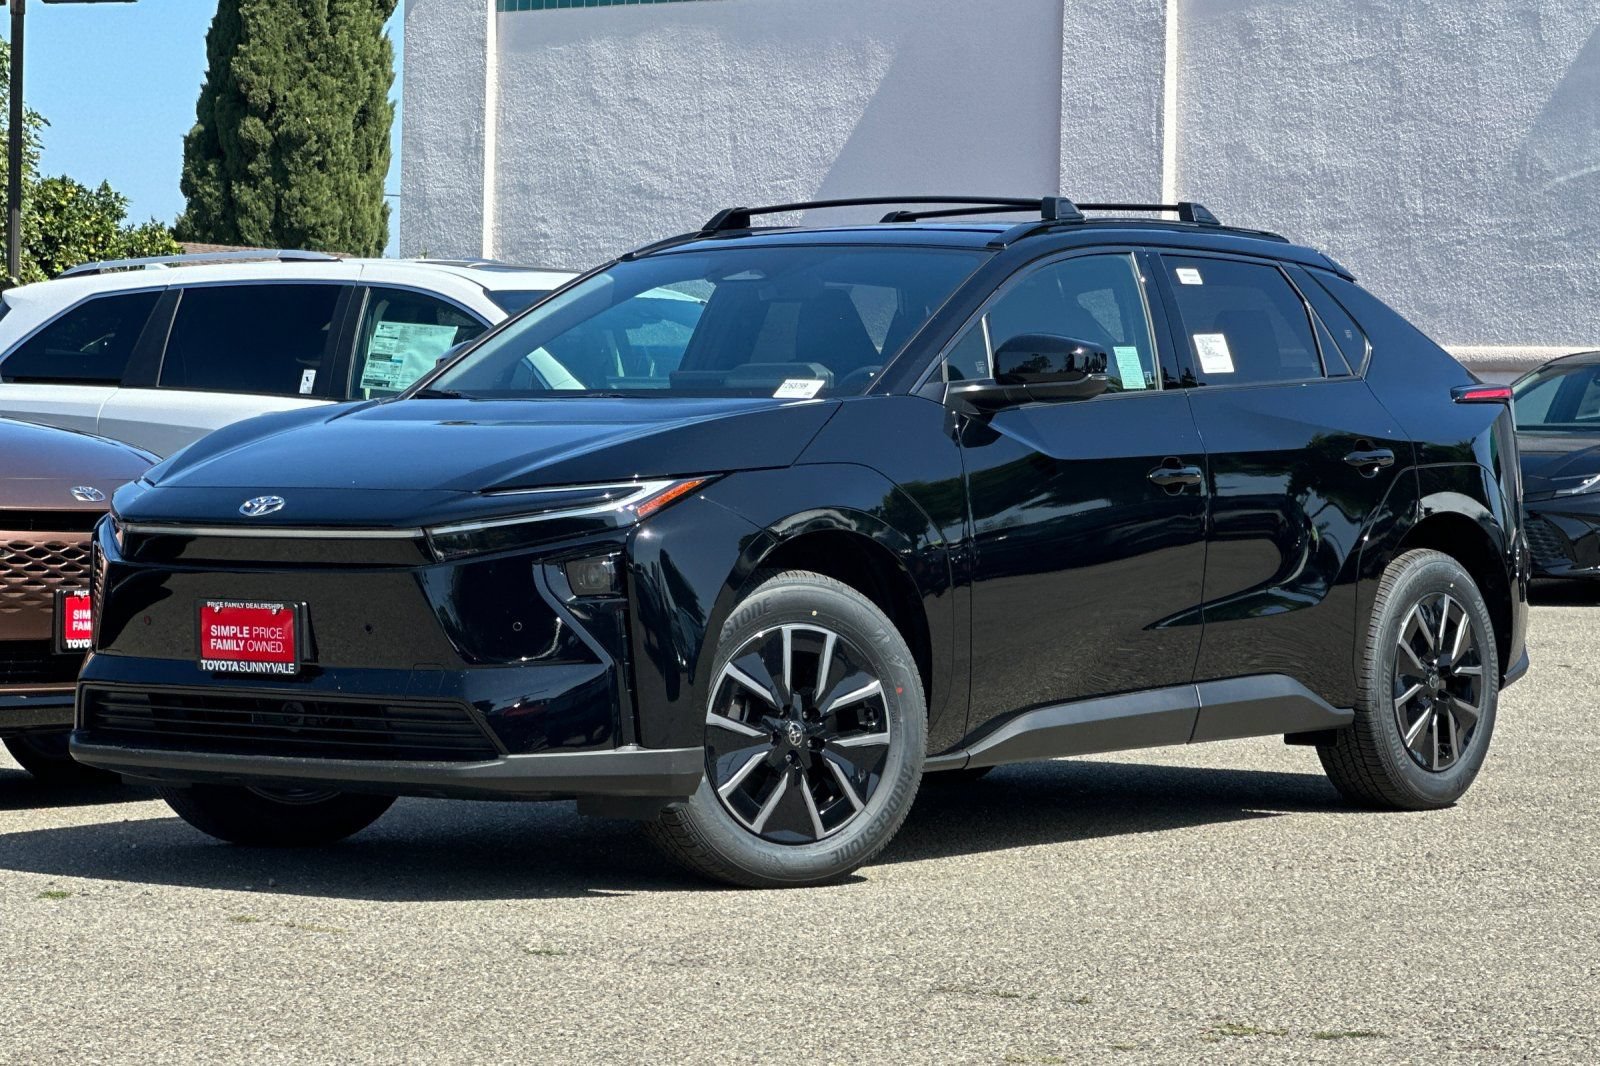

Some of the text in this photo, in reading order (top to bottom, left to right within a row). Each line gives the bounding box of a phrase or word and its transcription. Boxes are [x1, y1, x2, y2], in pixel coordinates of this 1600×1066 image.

[245, 602, 285, 610] DEALERSHIPS
[210, 625, 286, 639] SIMPLE PRICE.
[66, 638, 92, 649] TOYO
[210, 638, 286, 653] FAMILY OWNED.
[830, 763, 915, 867] BRIDGESTONE
